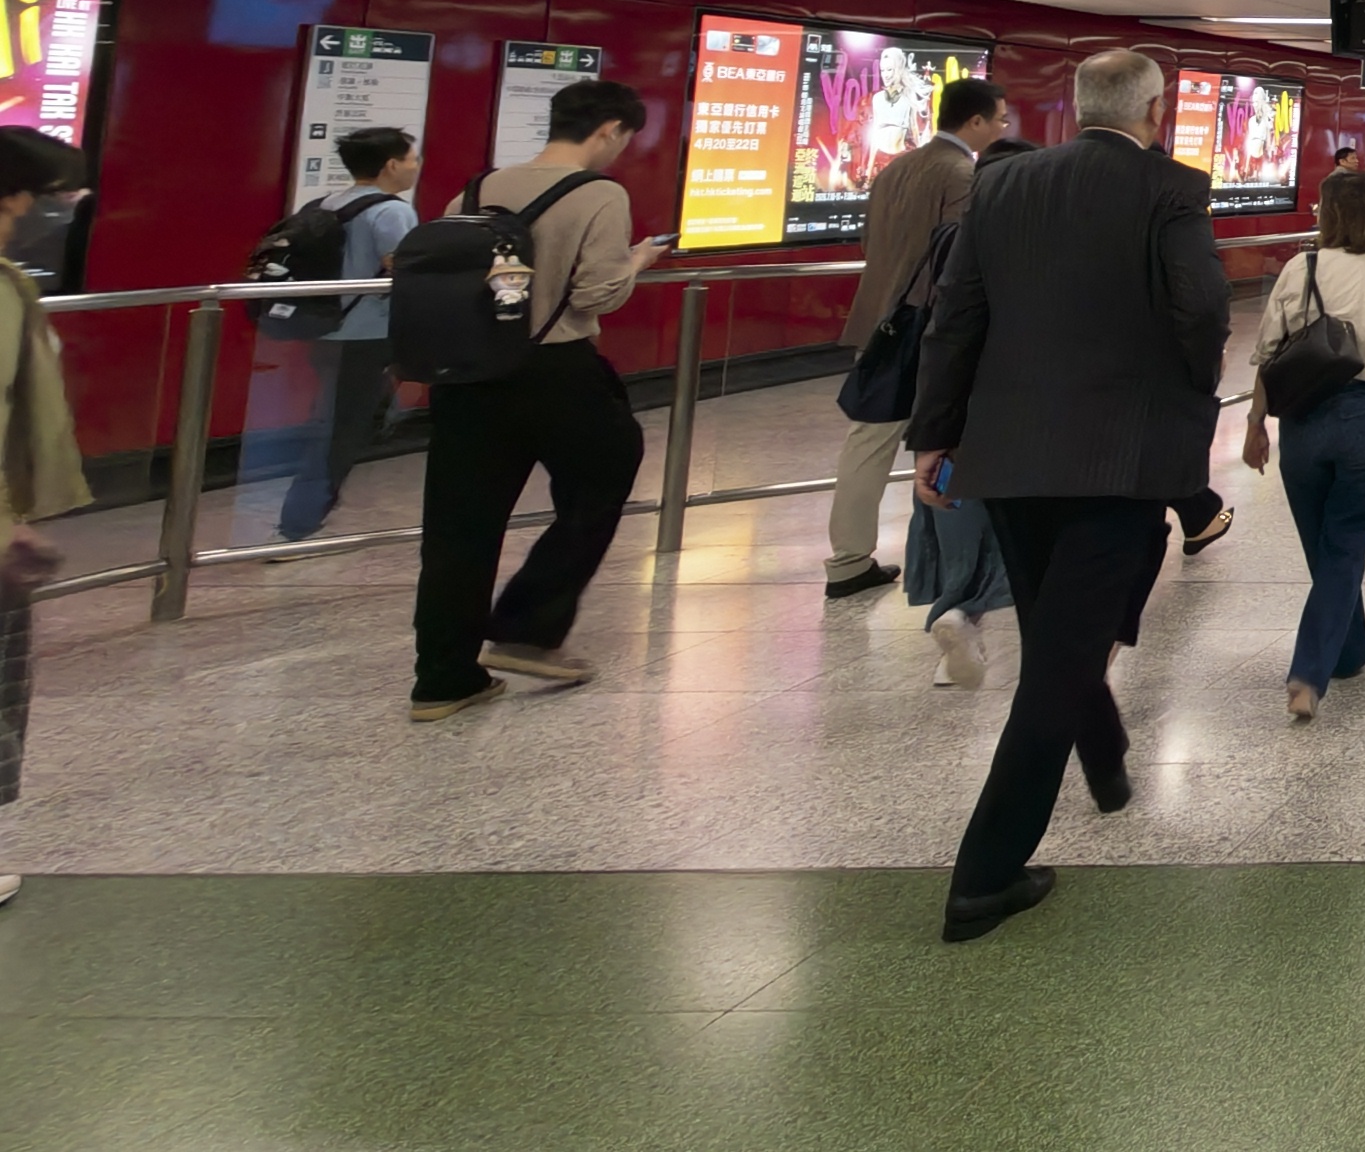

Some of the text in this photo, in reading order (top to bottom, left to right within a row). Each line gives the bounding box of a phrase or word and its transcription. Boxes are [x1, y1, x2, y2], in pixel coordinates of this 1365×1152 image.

[45, 43, 83, 77] KAI
[717, 67, 745, 80] BEA
[39, 82, 79, 120] TAK
